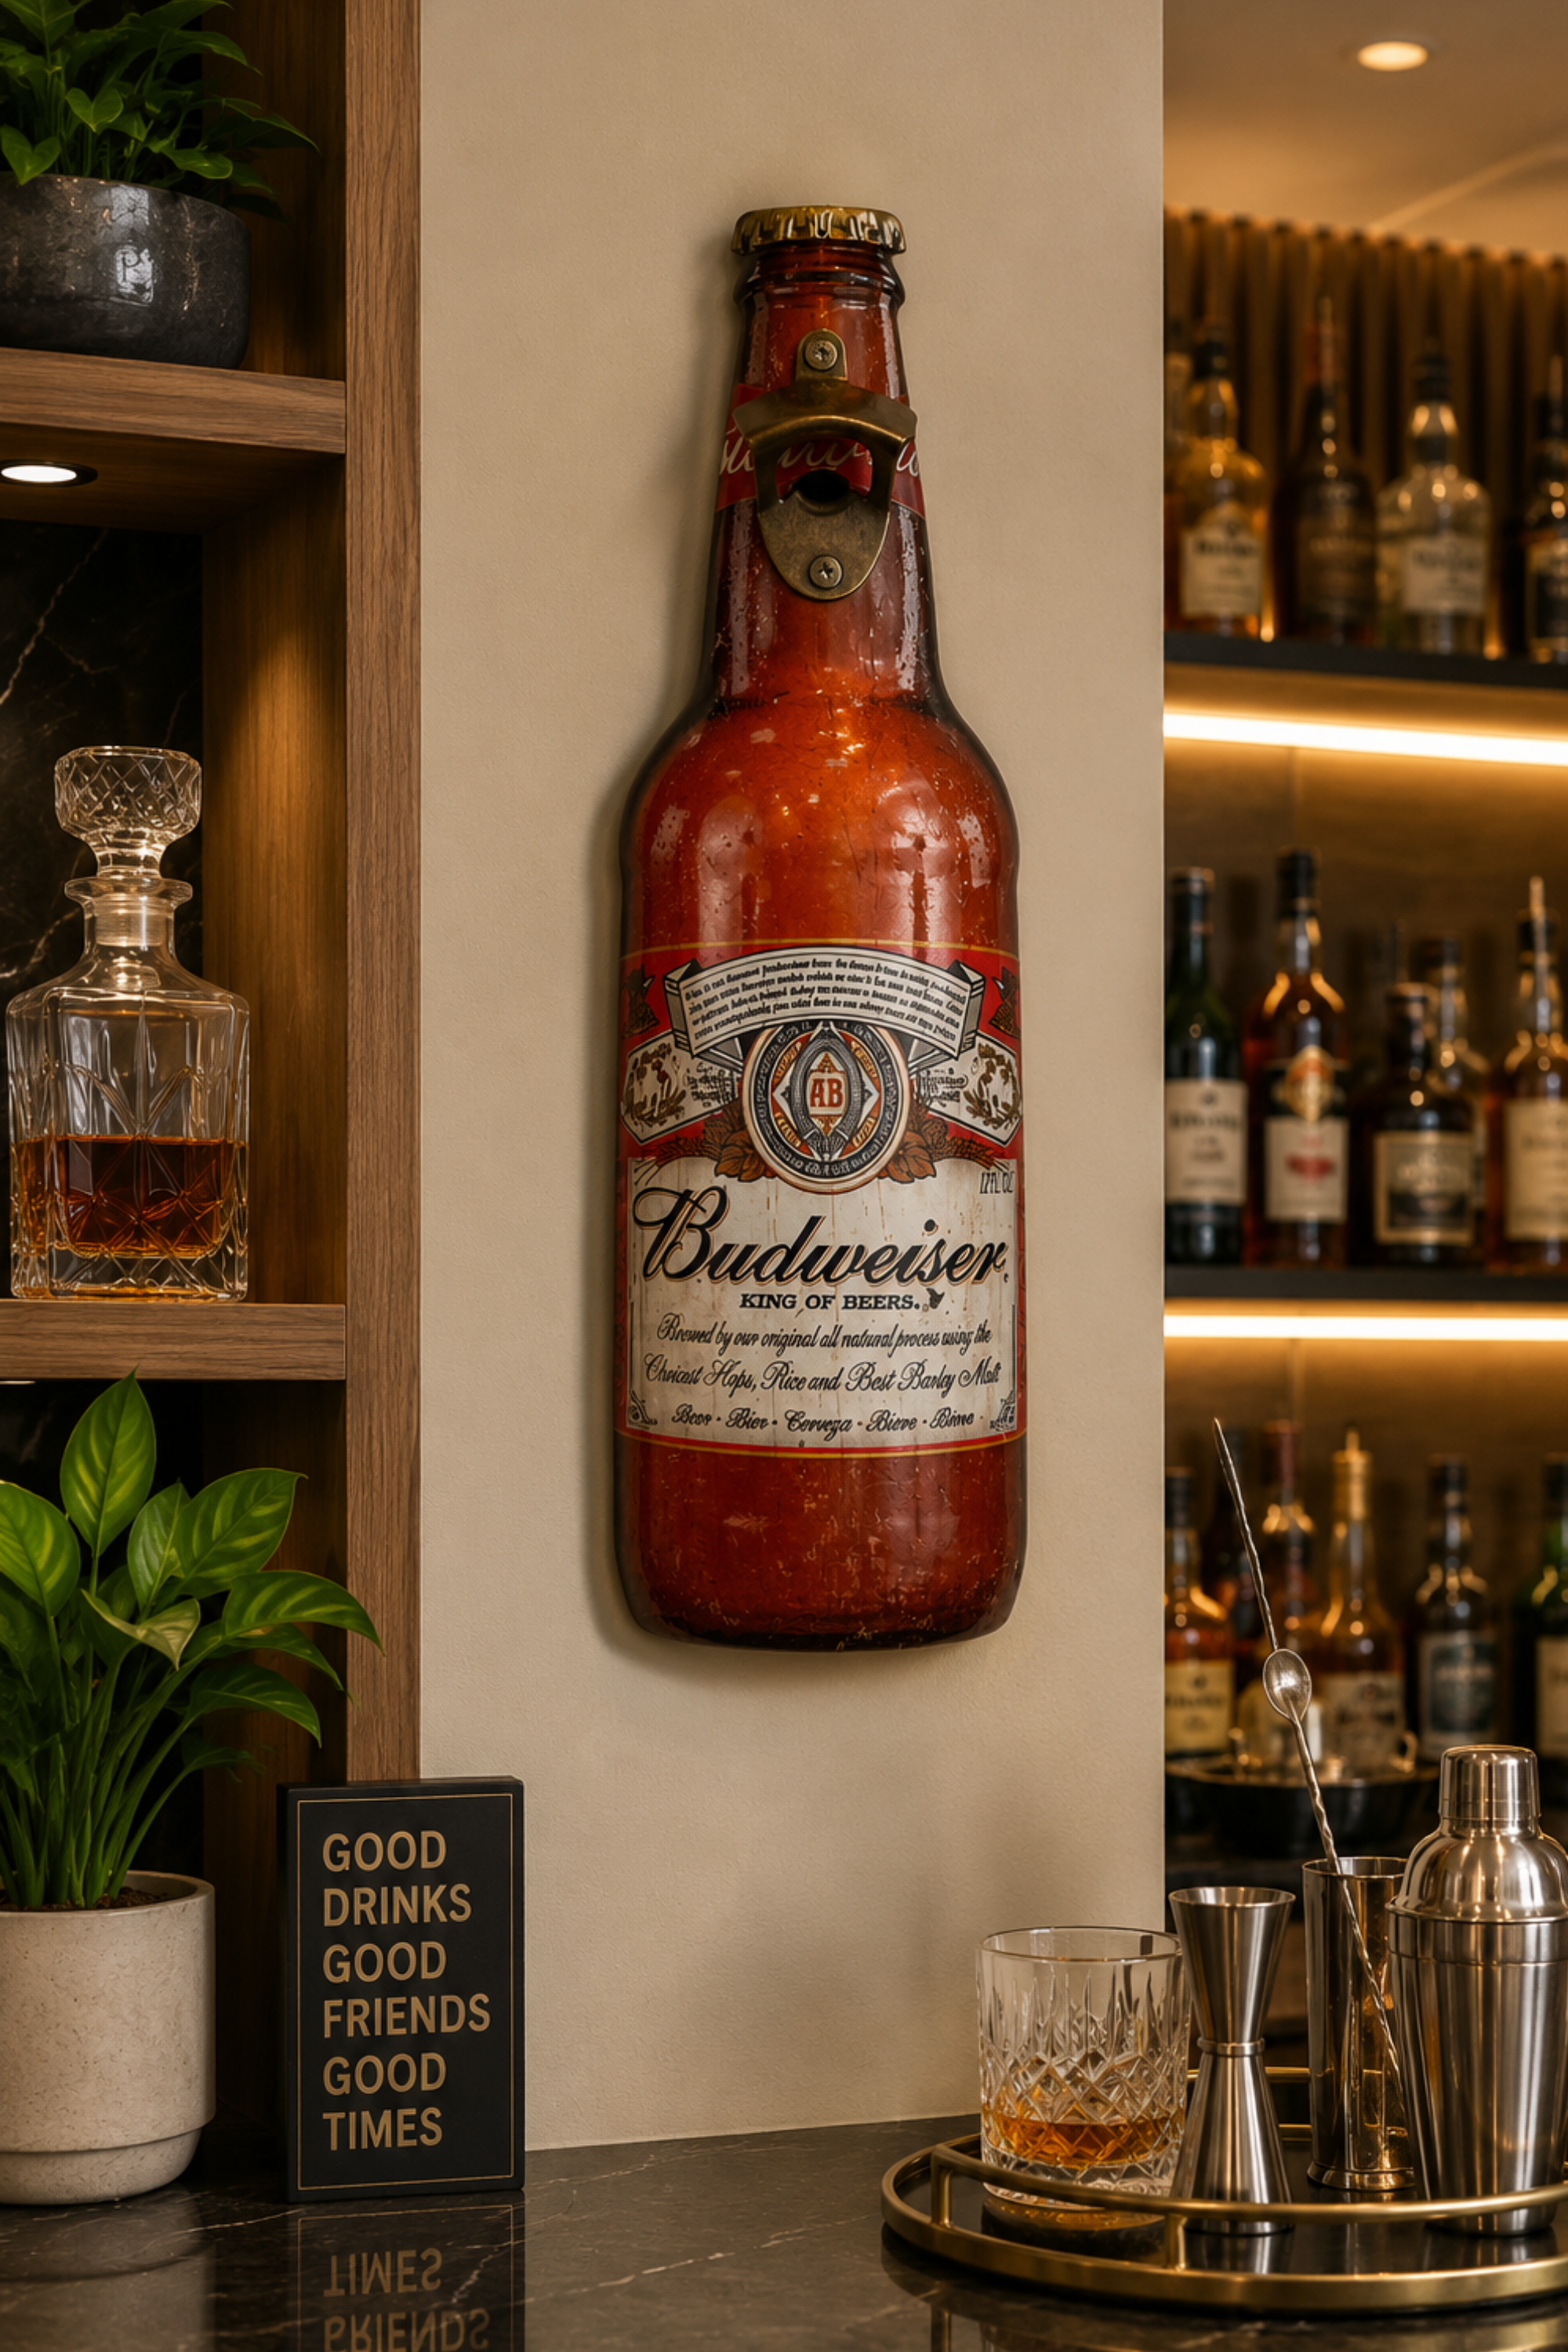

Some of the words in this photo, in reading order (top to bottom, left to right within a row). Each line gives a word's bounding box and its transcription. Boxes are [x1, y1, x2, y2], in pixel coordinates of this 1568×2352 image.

[810, 1078, 844, 1108] AB
[632, 1185, 1008, 1287] Budweiser
[739, 1294, 797, 1309] KING
[805, 1294, 835, 1309] OF
[842, 1295, 920, 1310] BEERS.
[715, 1320, 734, 1356] by
[733, 1332, 759, 1347] our
[760, 1325, 822, 1357] original
[819, 1324, 843, 1348] all
[841, 1323, 898, 1348] natural
[760, 1360, 807, 1391] Rice
[807, 1367, 844, 1392] and
[845, 1361, 897, 1392] Best
[322, 1831, 447, 1872] GOOD
[322, 1884, 472, 1927] DRINKS
[322, 1942, 447, 1984] GOOD
[323, 1994, 491, 2038] FRIENDS
[322, 2053, 447, 2096] GOOD
[322, 2107, 443, 2151] TIMES
